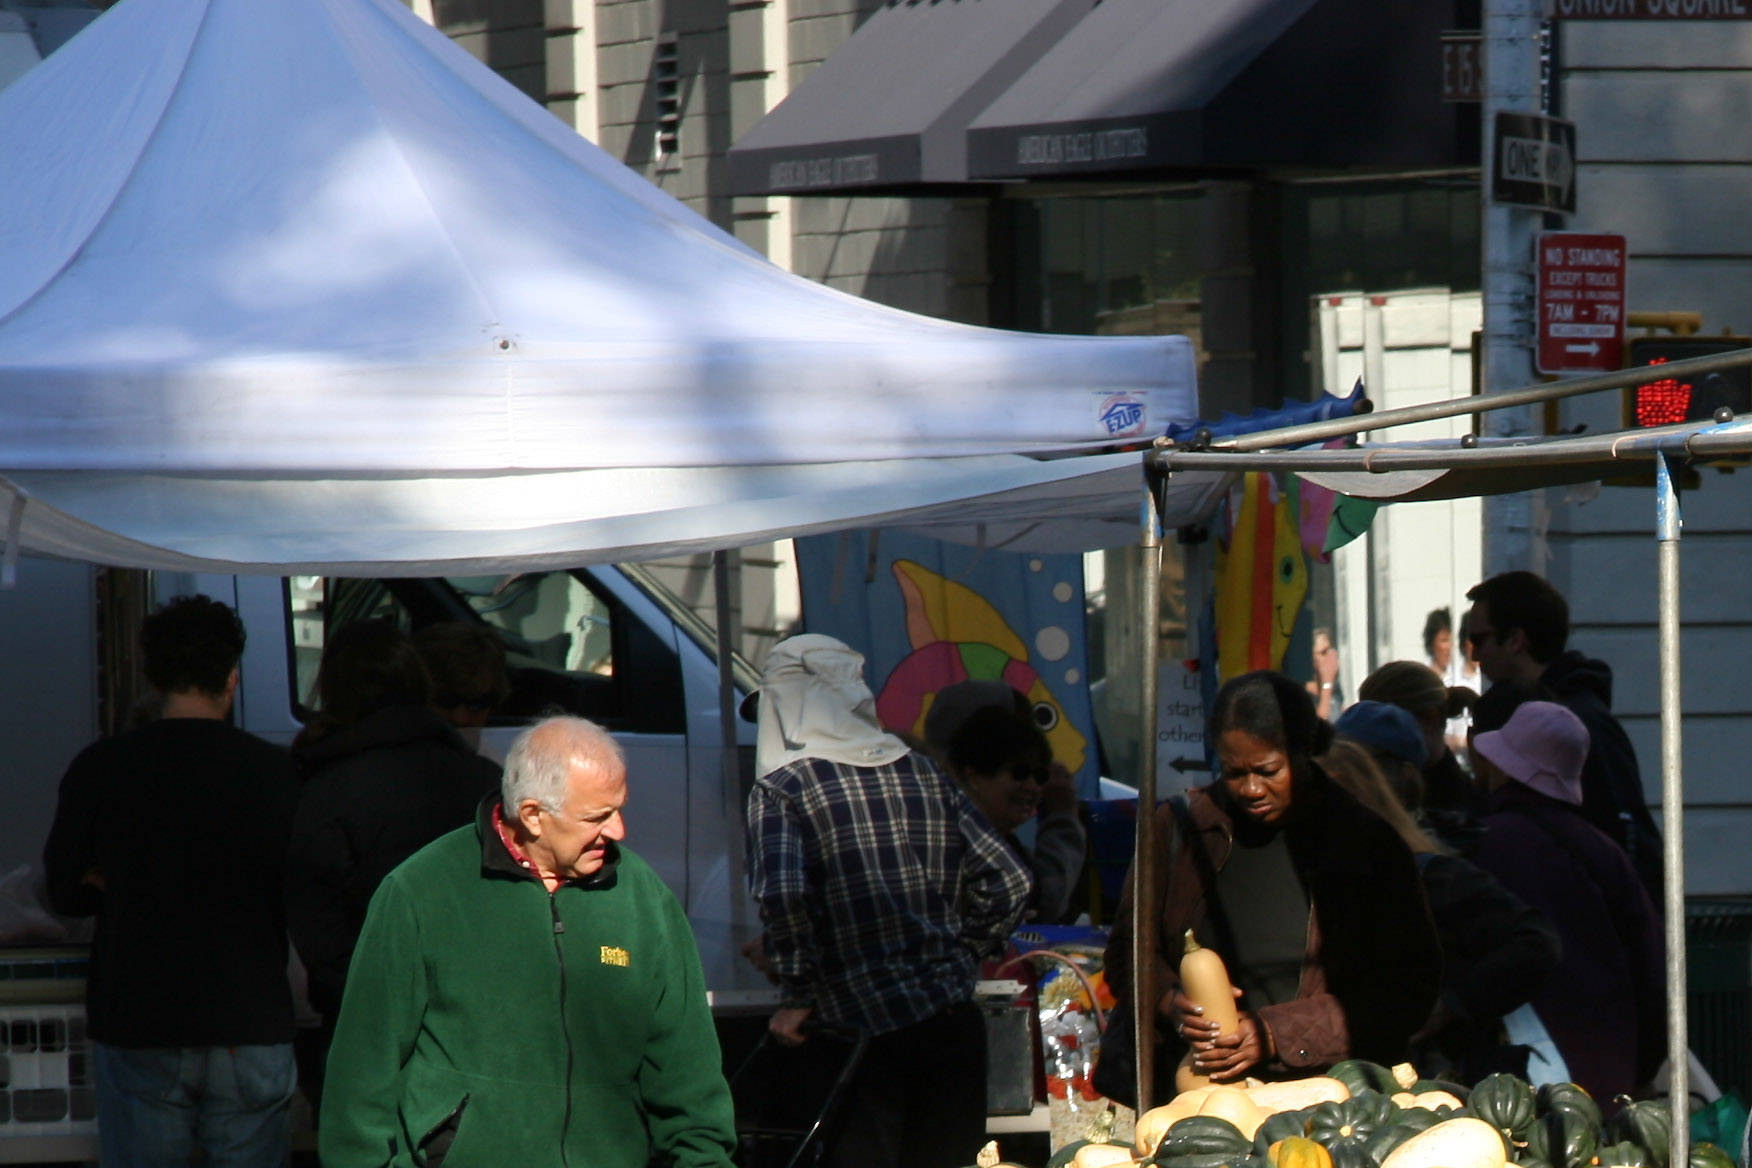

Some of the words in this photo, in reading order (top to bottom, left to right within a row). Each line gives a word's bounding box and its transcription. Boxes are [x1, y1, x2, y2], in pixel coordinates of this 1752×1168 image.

[1508, 141, 1541, 177] ONE
[1546, 248, 1564, 266] NO
[1568, 248, 1621, 267] STANDING
[1546, 303, 1575, 321] 7AM
[1594, 304, 1620, 322] 7PM
